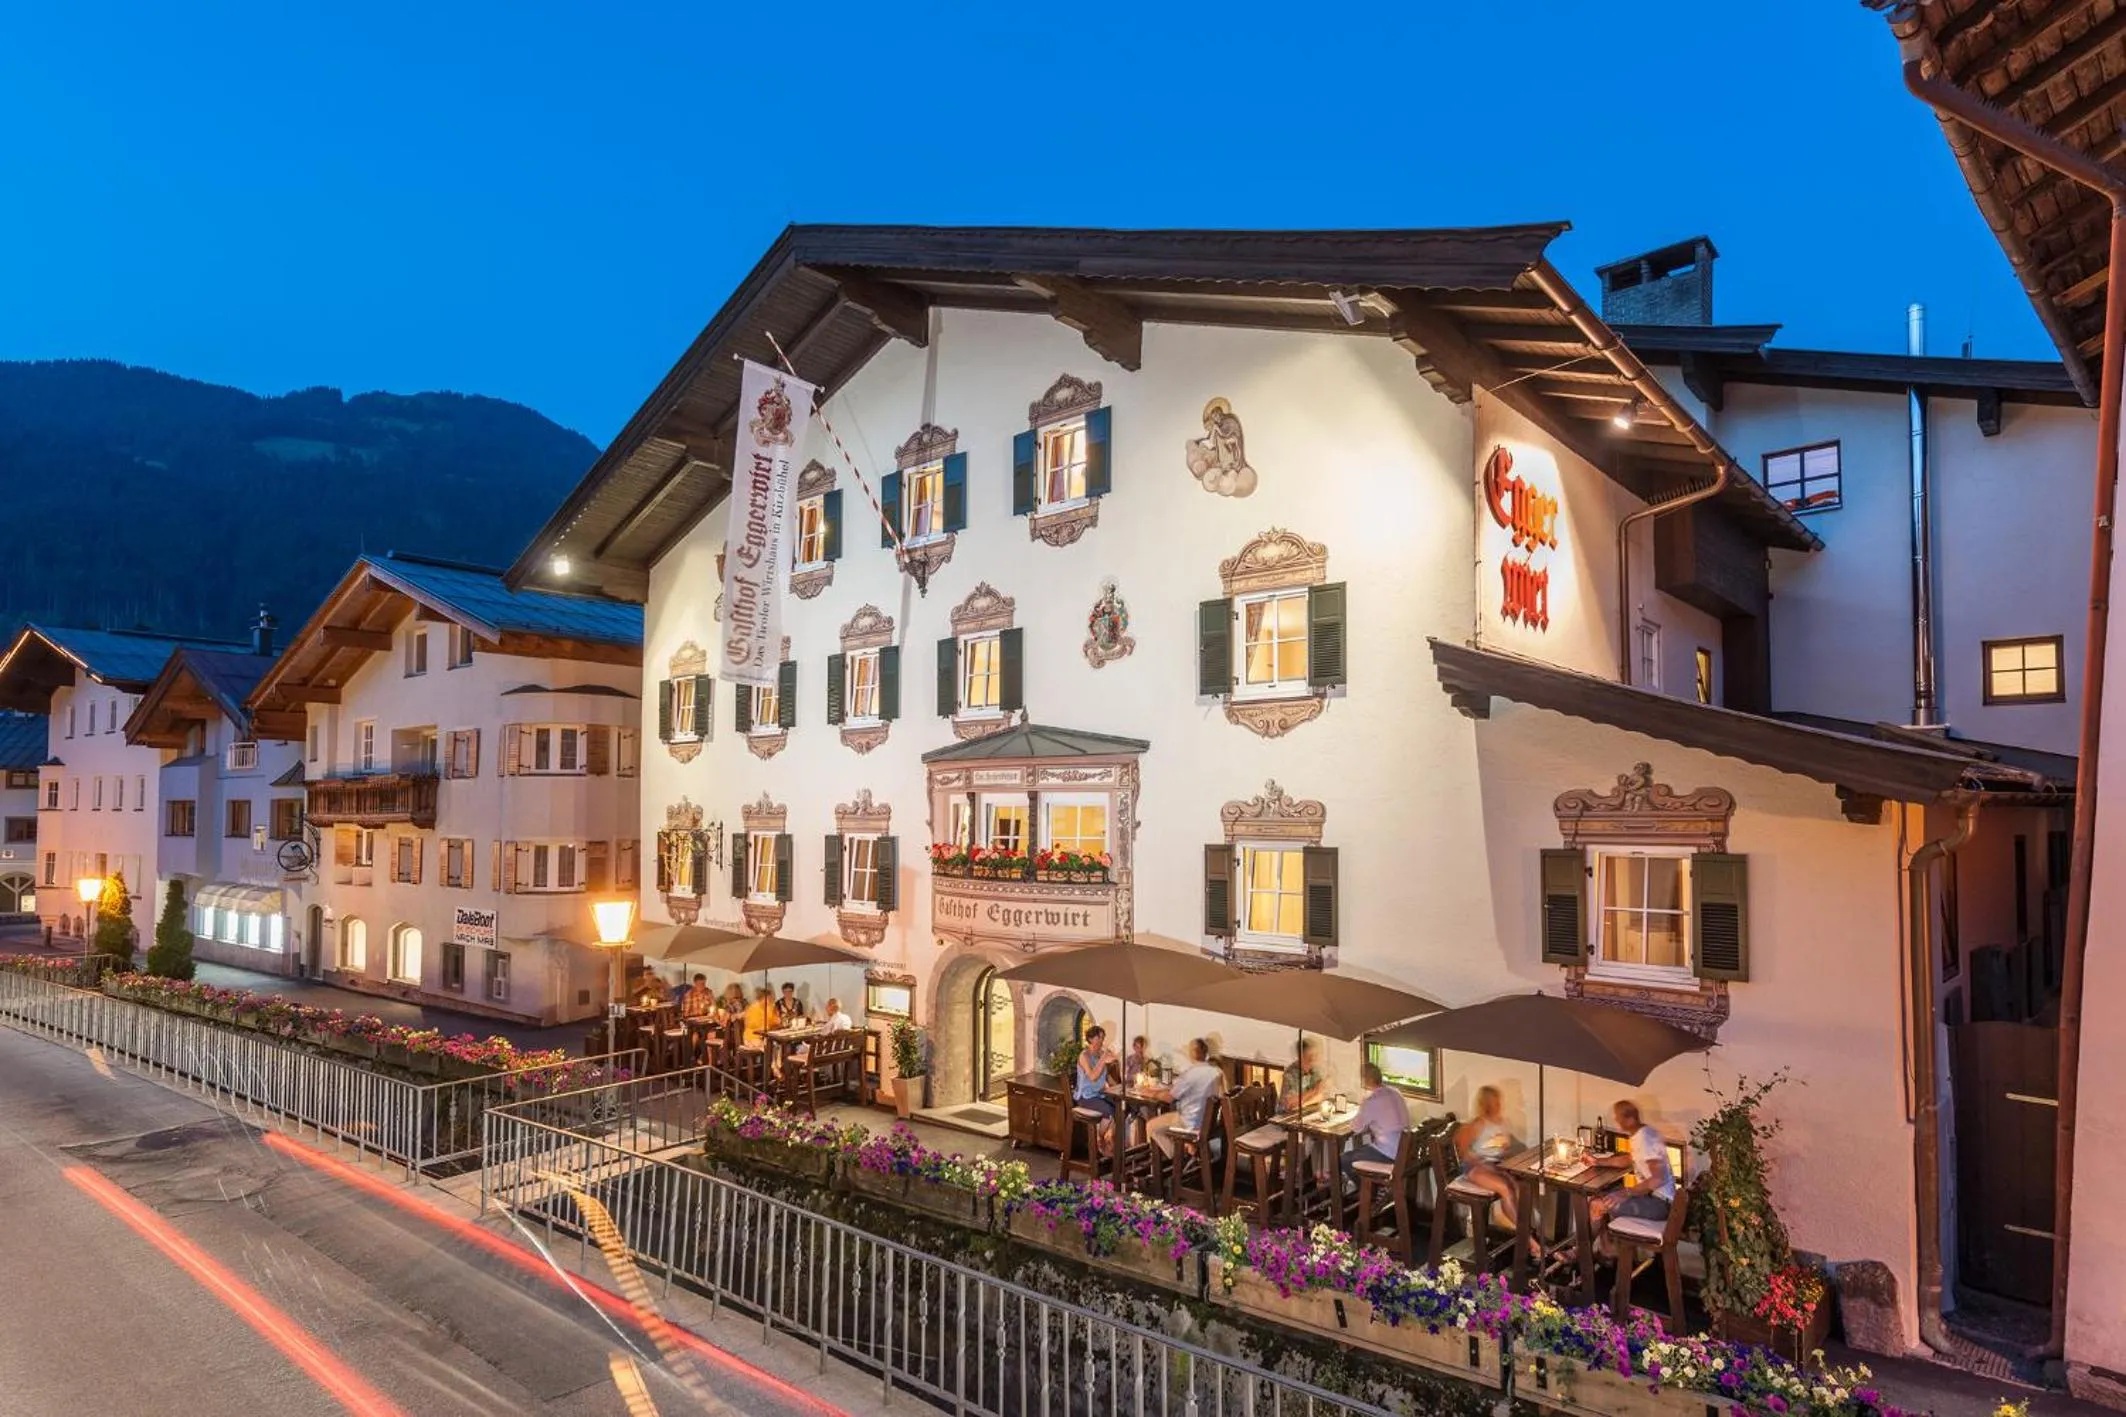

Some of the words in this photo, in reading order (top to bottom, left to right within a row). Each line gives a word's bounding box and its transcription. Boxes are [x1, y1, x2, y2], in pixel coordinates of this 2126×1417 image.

[737, 453, 774, 568] Eggerwirt
[772, 460, 790, 518] Kitzbühel
[761, 538, 779, 597] Wirtshaus
[755, 602, 770, 643] Tiroler
[753, 646, 764, 667] Das
[987, 904, 1091, 928] Eggerwirt
